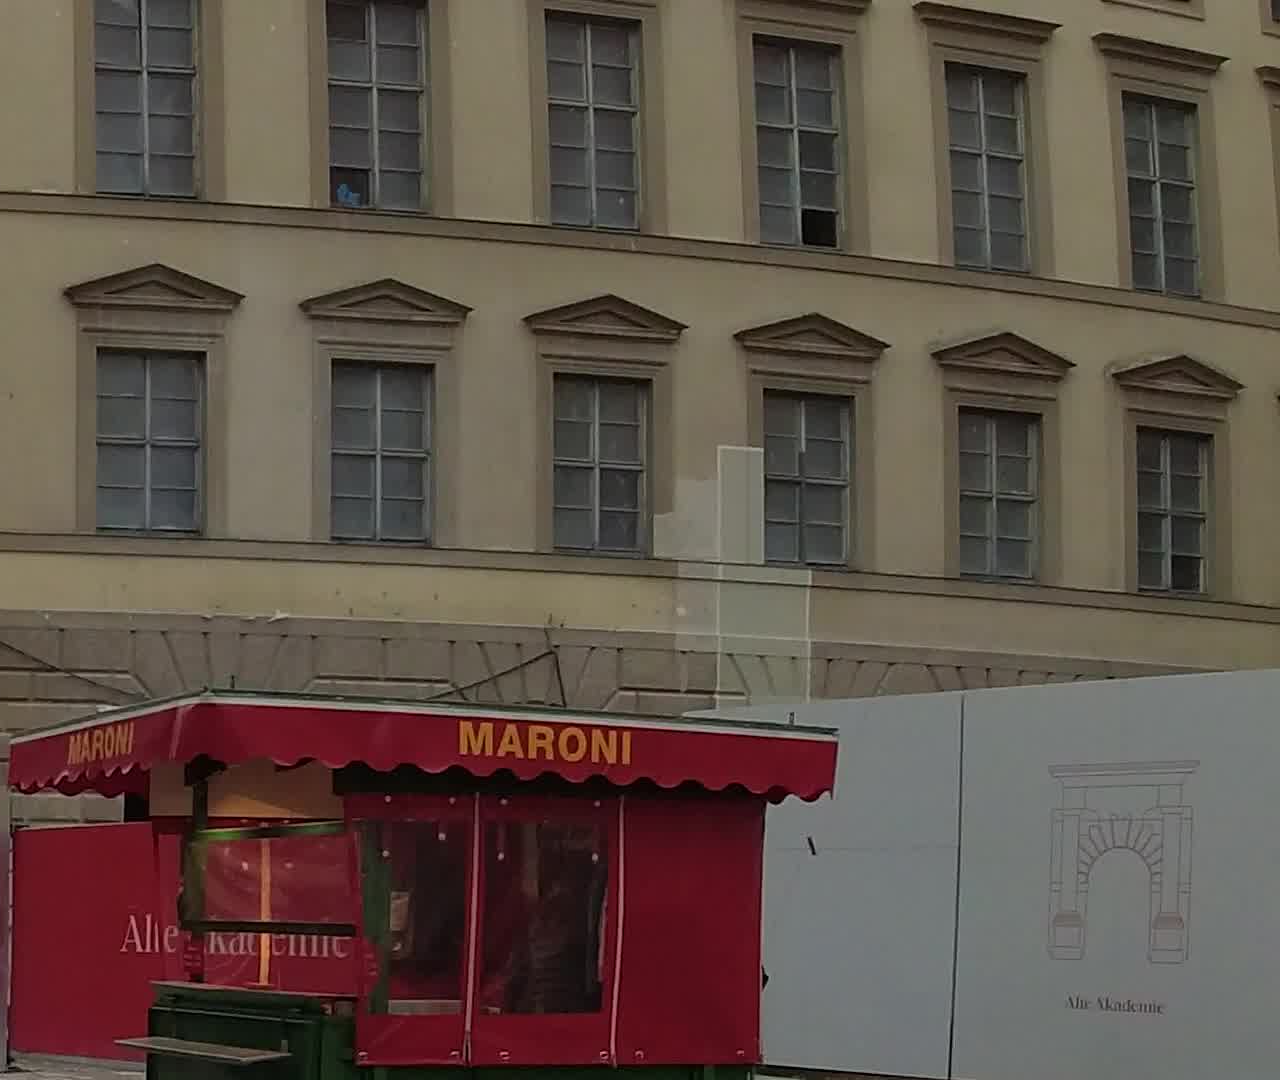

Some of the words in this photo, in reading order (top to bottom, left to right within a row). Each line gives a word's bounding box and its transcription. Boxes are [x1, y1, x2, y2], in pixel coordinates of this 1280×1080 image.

[67, 720, 135, 765] MARONI
[459, 720, 632, 765] MARONI
[119, 912, 178, 954] Alte
